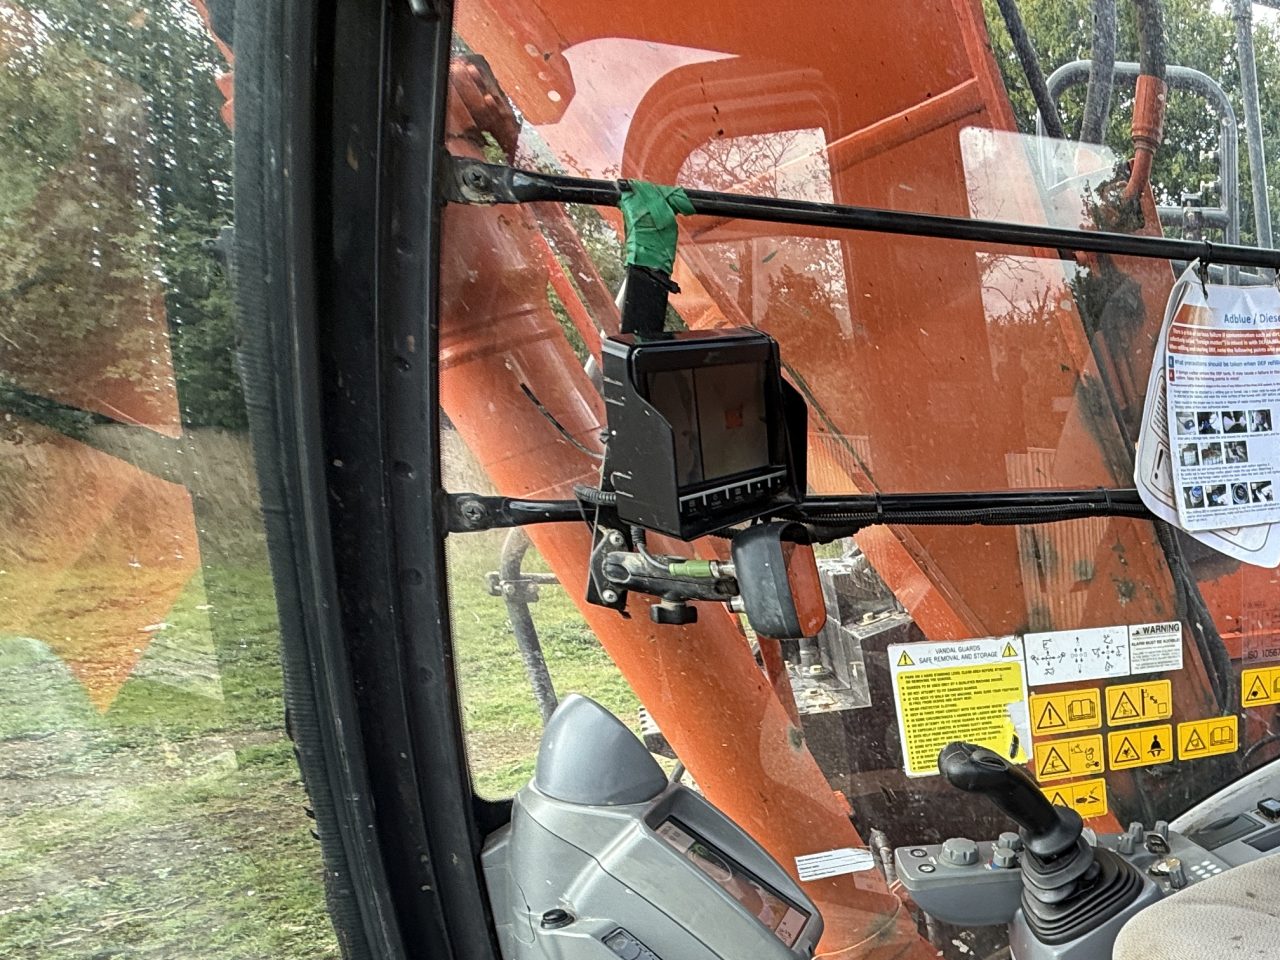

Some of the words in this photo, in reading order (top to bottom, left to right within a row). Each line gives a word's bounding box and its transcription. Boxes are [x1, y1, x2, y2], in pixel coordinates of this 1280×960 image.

[1224, 313, 1251, 323] Adblue
[1143, 624, 1179, 634] WARNING
[935, 646, 956, 654] VANDAL
[958, 645, 981, 653] GUARDS
[919, 656, 932, 664] SAFE
[934, 654, 960, 662] REMOVAL
[961, 653, 972, 661] AND
[973, 651, 998, 659] STORAGE
